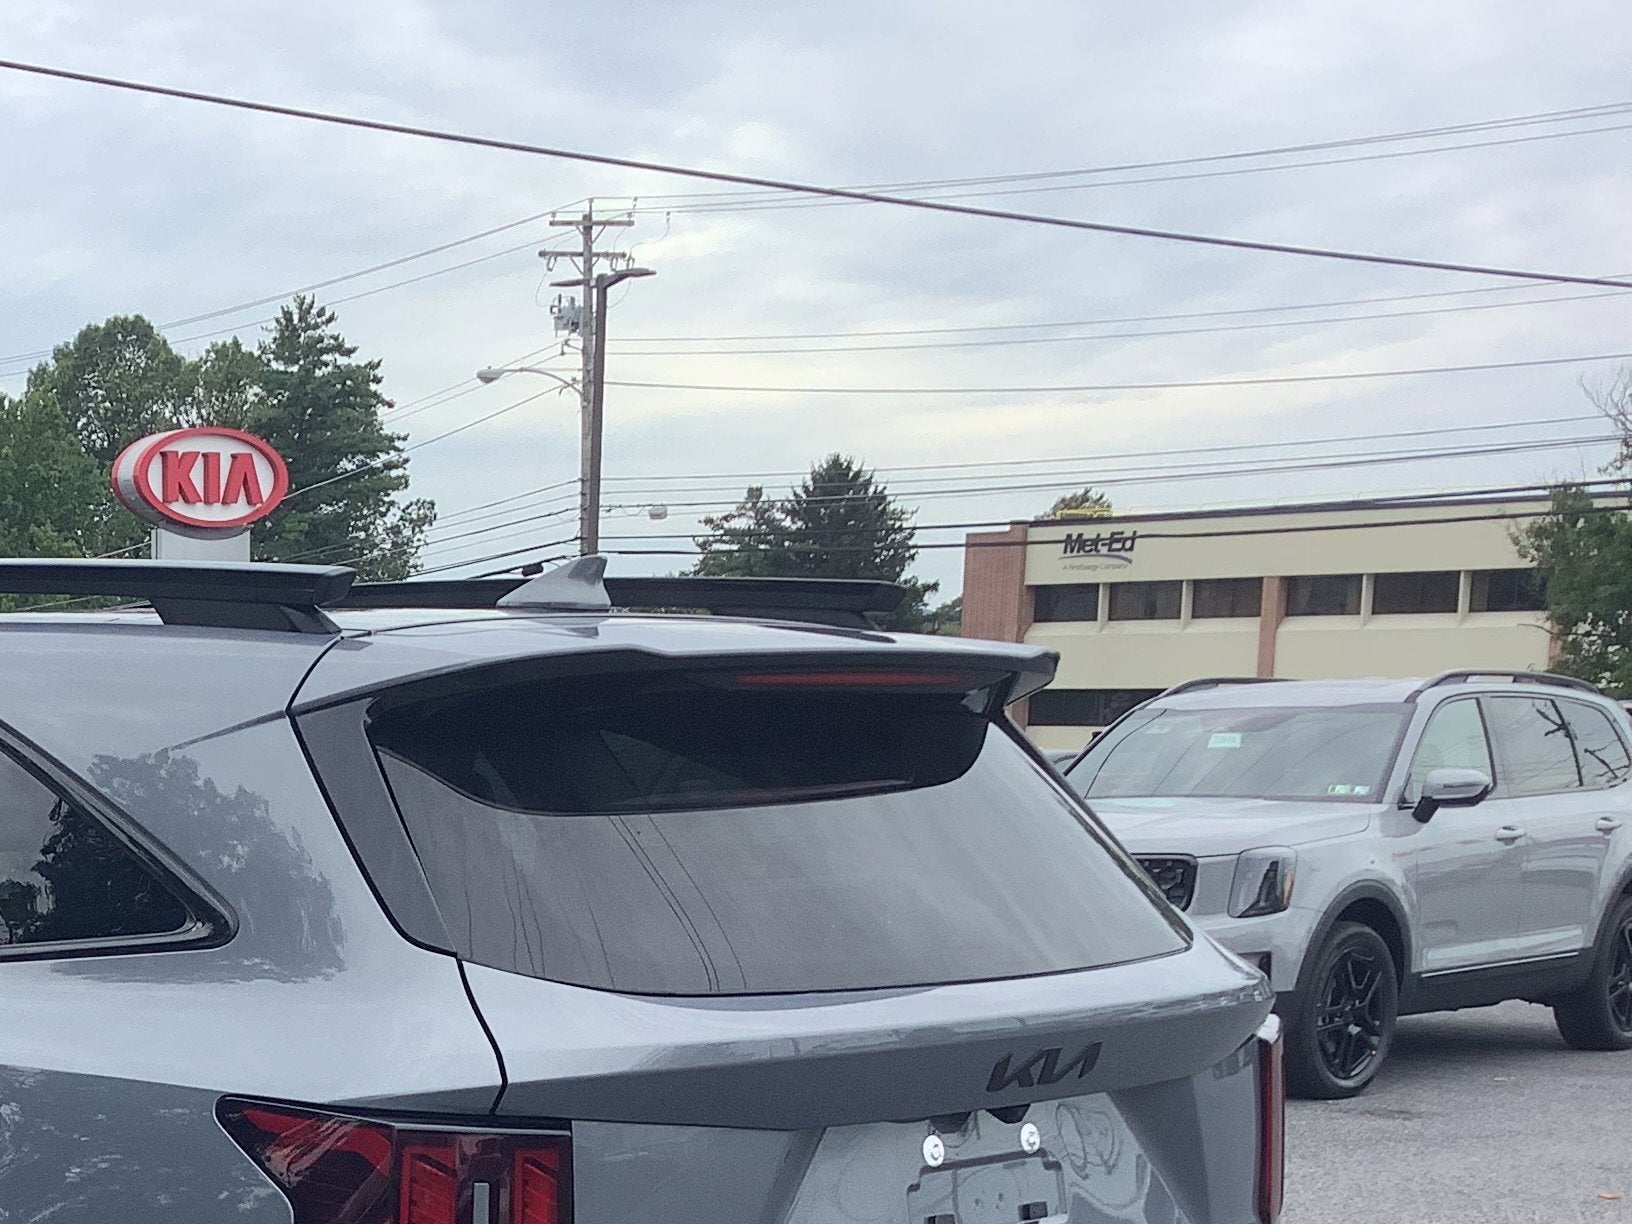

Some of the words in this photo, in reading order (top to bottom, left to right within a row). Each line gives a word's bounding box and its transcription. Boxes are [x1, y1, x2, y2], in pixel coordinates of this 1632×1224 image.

[160, 451, 264, 506] KIA
[1063, 530, 1138, 555] Met-Ed
[986, 1041, 1103, 1092] KIA
